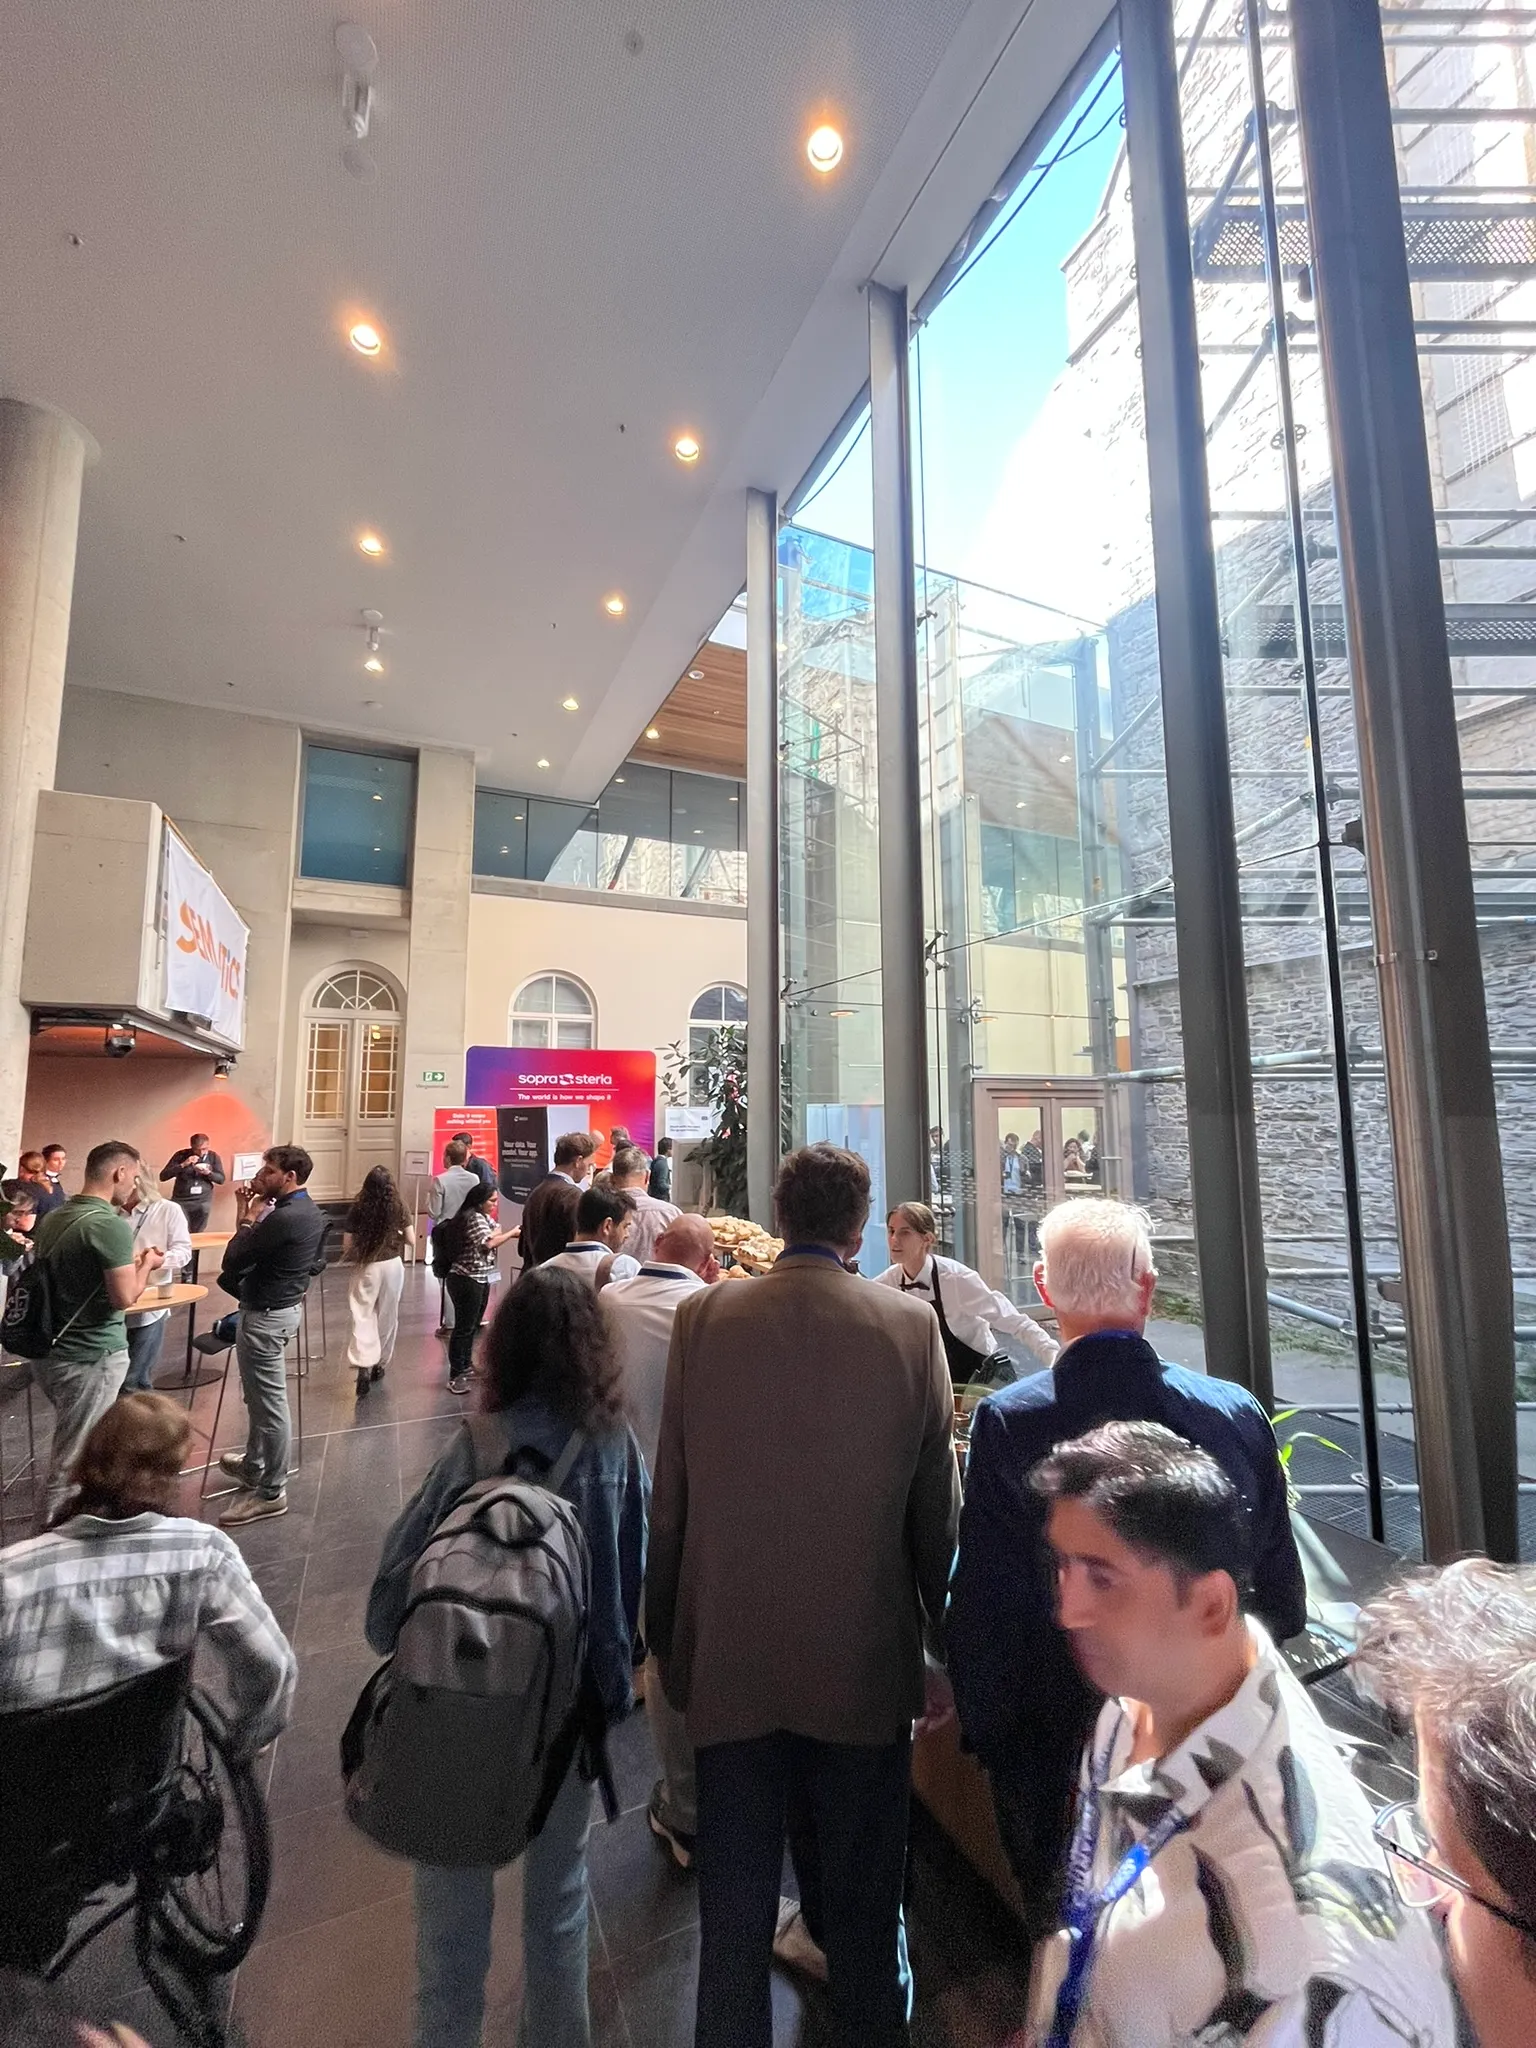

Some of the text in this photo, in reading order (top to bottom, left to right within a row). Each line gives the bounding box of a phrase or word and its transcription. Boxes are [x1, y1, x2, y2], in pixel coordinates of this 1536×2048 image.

[518, 1074, 612, 1086] sopra steria
[586, 1094, 605, 1102] shape
